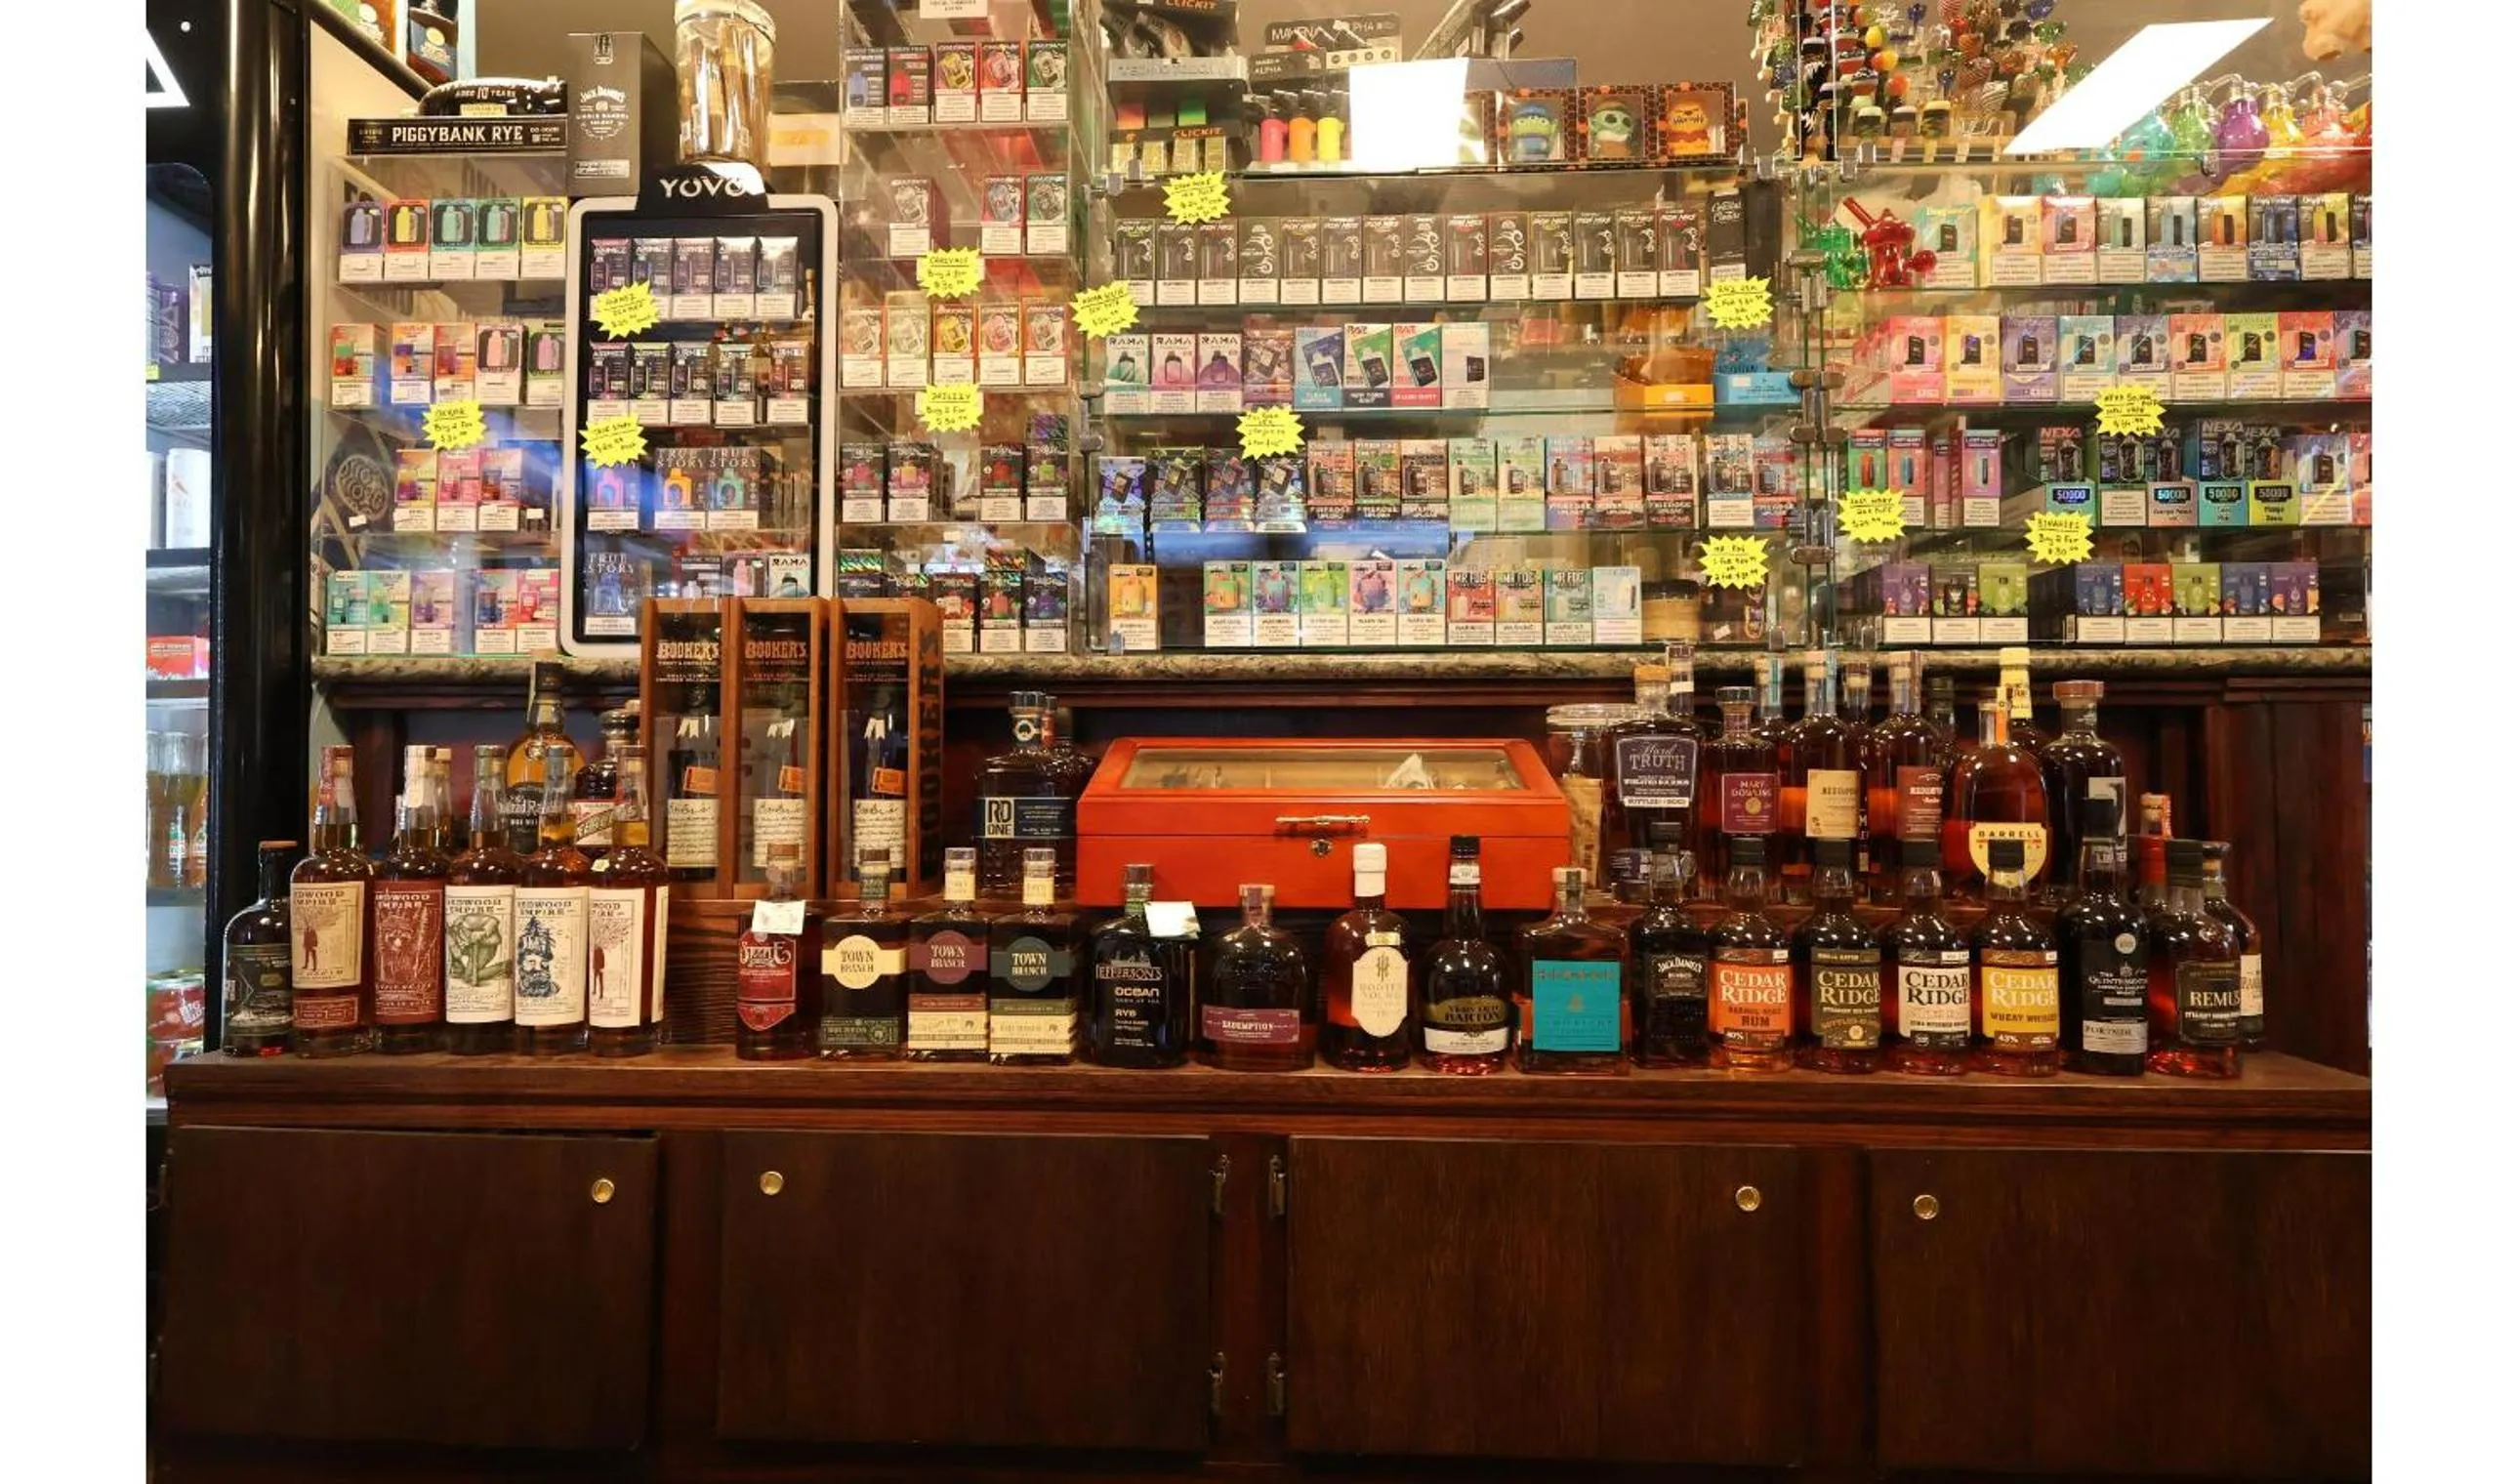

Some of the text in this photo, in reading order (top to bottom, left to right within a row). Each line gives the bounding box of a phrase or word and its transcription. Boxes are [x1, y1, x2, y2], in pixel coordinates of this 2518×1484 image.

[392, 126, 486, 144] PIGGYBANK
[491, 125, 523, 142] RYE
[1109, 337, 1144, 346] RAMA
[1156, 337, 1191, 346] RAMA
[1202, 337, 1238, 346] RAMA
[2040, 427, 2083, 438] NEXA
[2203, 421, 2244, 433] NEXA
[771, 558, 808, 567] RAMA
[657, 640, 719, 660] BOOKER'S
[745, 641, 807, 659] BOOKER'S
[846, 641, 908, 659] BOOKER'S
[1630, 754, 1686, 771] TRUTH
[987, 824, 1012, 836] ONE
[1978, 830, 2042, 839] BARRELL
[840, 950, 875, 963] TOWN
[931, 944, 966, 958] TOWN
[931, 959, 966, 969] BRANCH
[1011, 953, 1047, 966] TOWN
[840, 964, 875, 973] BRANCH
[1011, 967, 1047, 975] BRANCH
[1719, 969, 1786, 989] CEDAR
[1817, 970, 1880, 988] CEDAR
[1905, 970, 1968, 988] CEDAR
[1989, 971, 2055, 989] CEDAR
[1721, 985, 1788, 1004] RIDGE
[1820, 986, 1881, 1006] RIDGE
[1907, 988, 1969, 1006] RIDGE
[1991, 989, 2057, 1007] RIDGE
[2190, 991, 2241, 1007] REMUS
[1741, 1016, 1770, 1027] RUM
